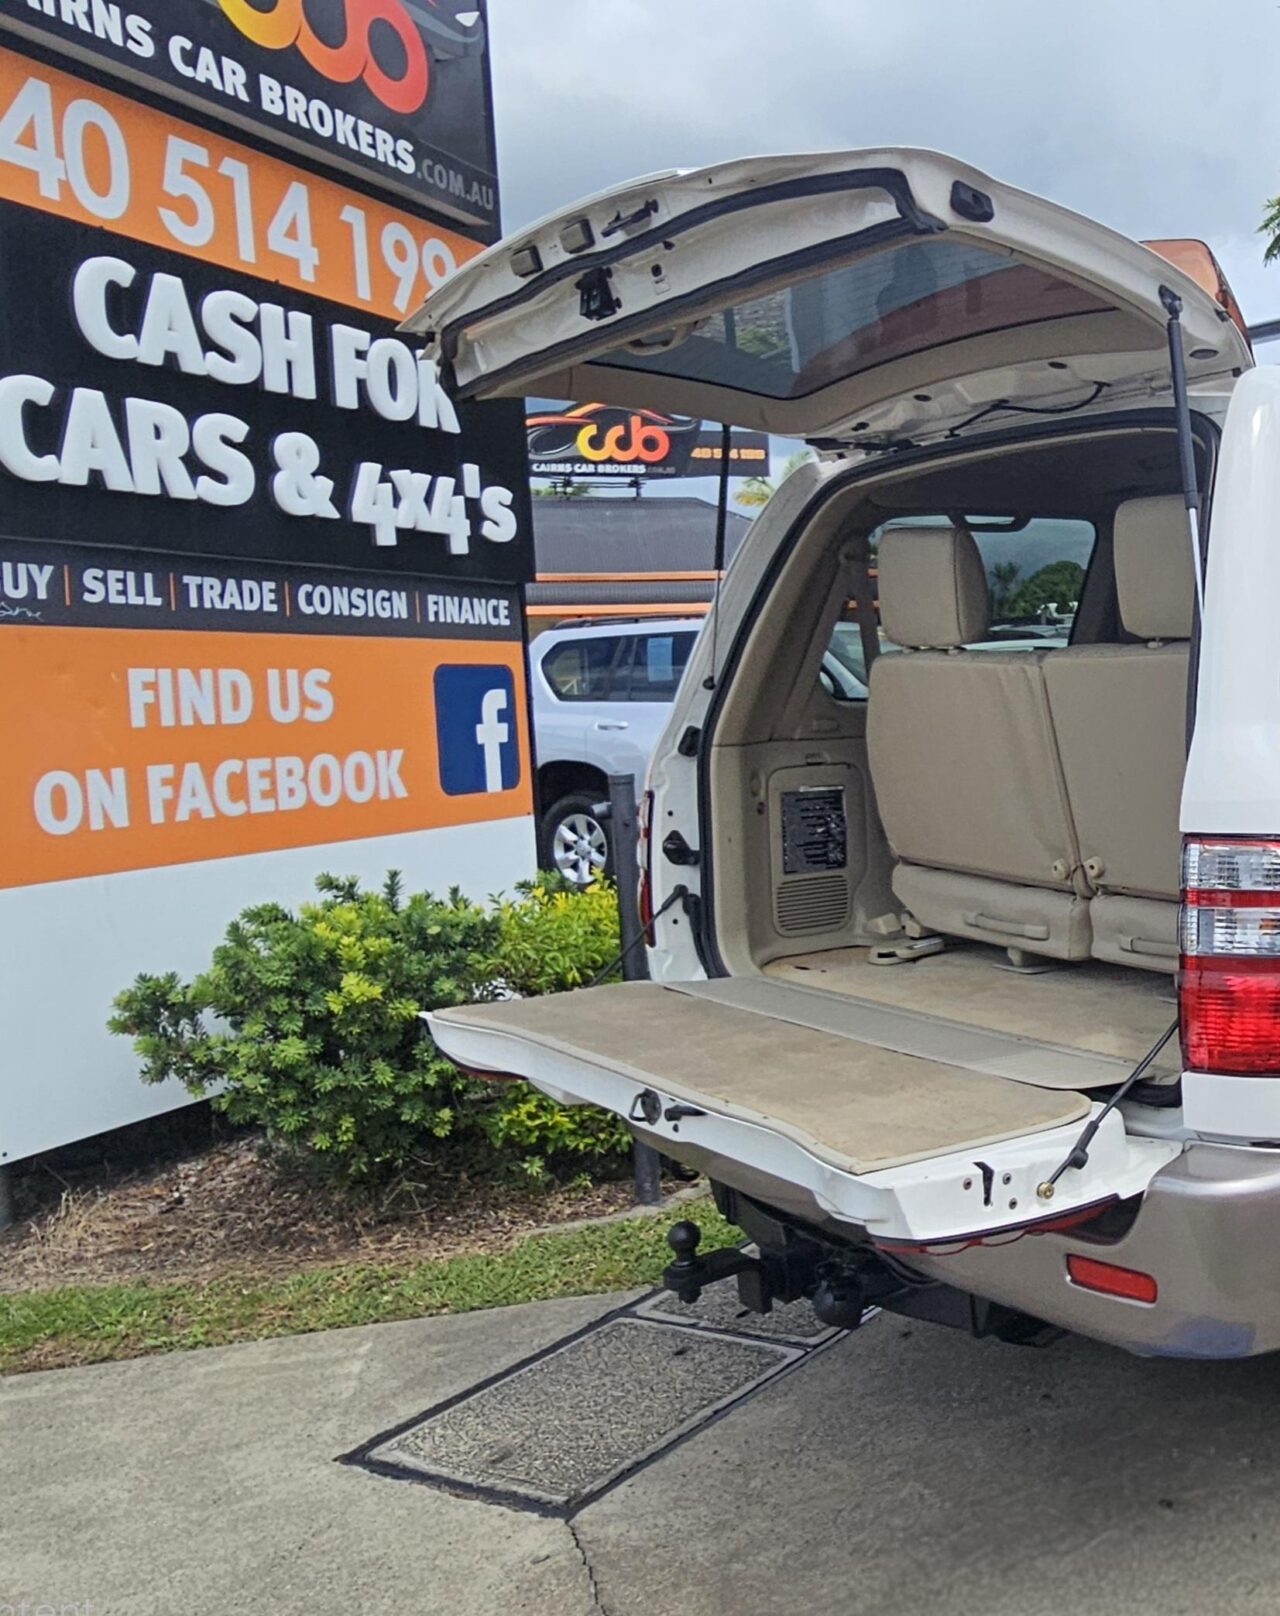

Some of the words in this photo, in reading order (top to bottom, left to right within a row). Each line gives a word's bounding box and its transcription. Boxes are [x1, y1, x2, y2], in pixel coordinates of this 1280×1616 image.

[169, 36, 250, 103] CAR
[157, 134, 319, 282] 514
[72, 256, 317, 400] CASH
[0, 374, 256, 506] CARS
[271, 432, 341, 519] &
[573, 463, 596, 474] CAR
[0, 561, 55, 600] UY
[82, 567, 162, 607] SELL
[182, 574, 278, 612] TRADE
[297, 583, 408, 619] CONSIGN
[427, 593, 511, 626] FINANCE
[127, 667, 254, 728] FIND
[267, 668, 334, 724] US
[33, 766, 131, 836] ON
[146, 748, 409, 825] FACEBOOK
